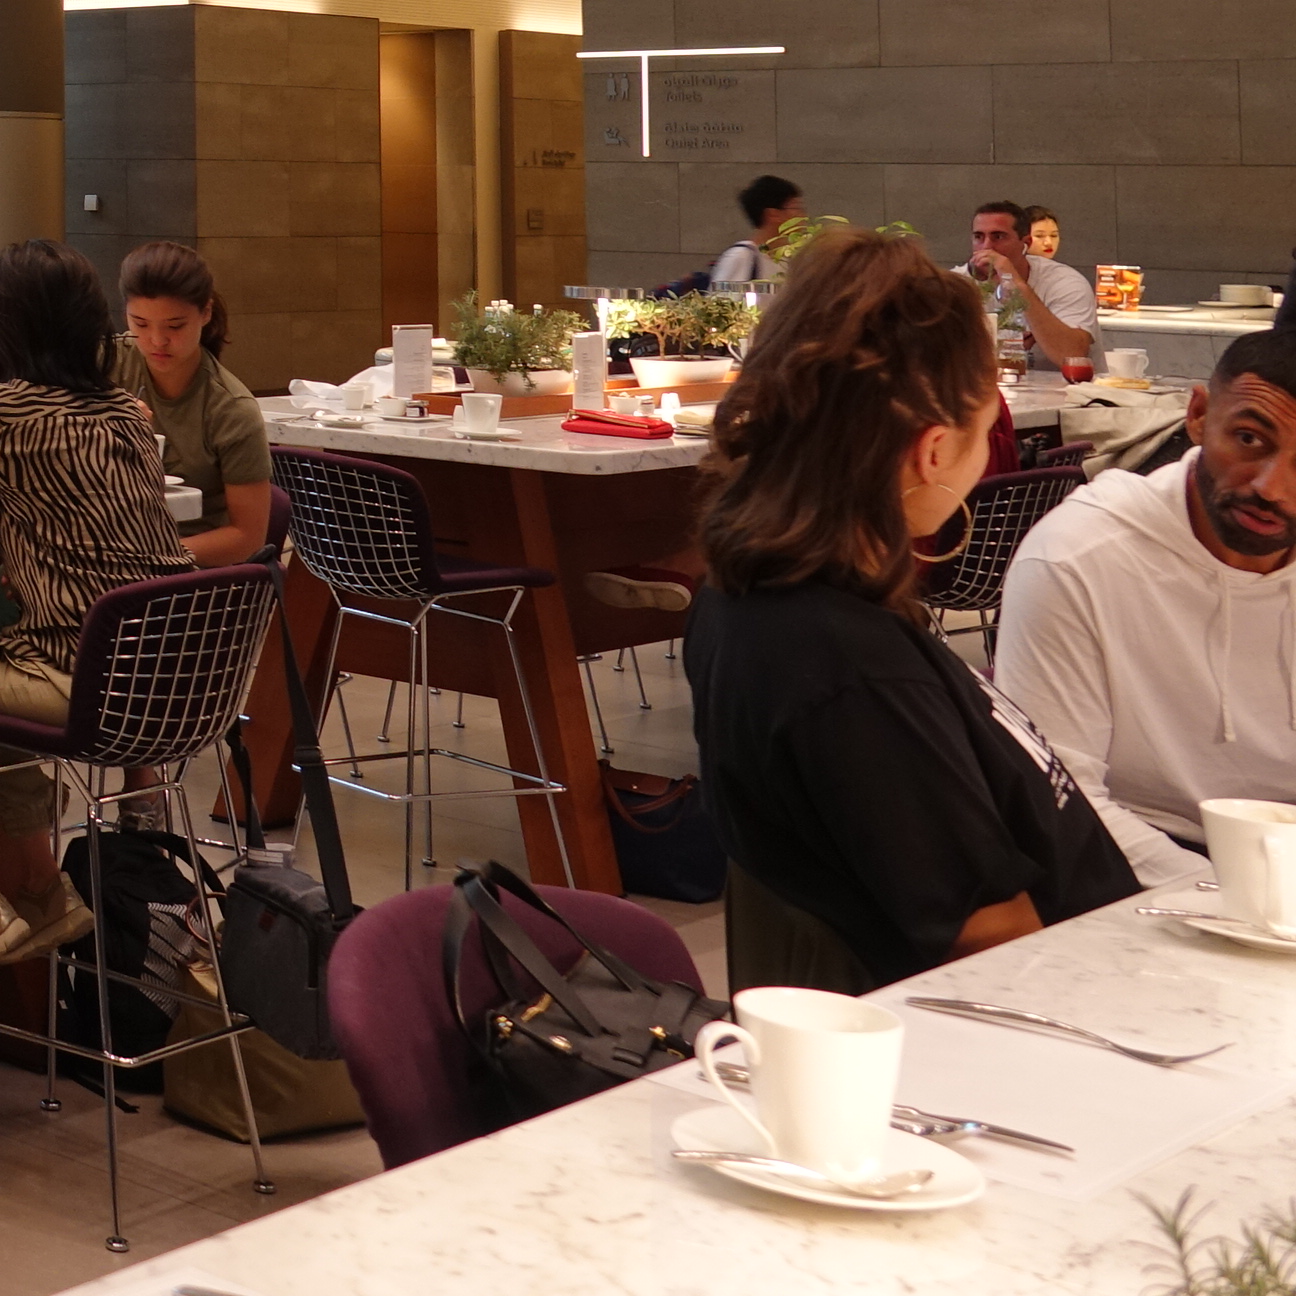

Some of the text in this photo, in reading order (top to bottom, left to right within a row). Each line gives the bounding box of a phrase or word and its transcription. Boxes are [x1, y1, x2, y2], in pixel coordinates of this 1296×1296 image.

[665, 91, 703, 103] Toilets
[665, 138, 730, 150] Quiet Area
